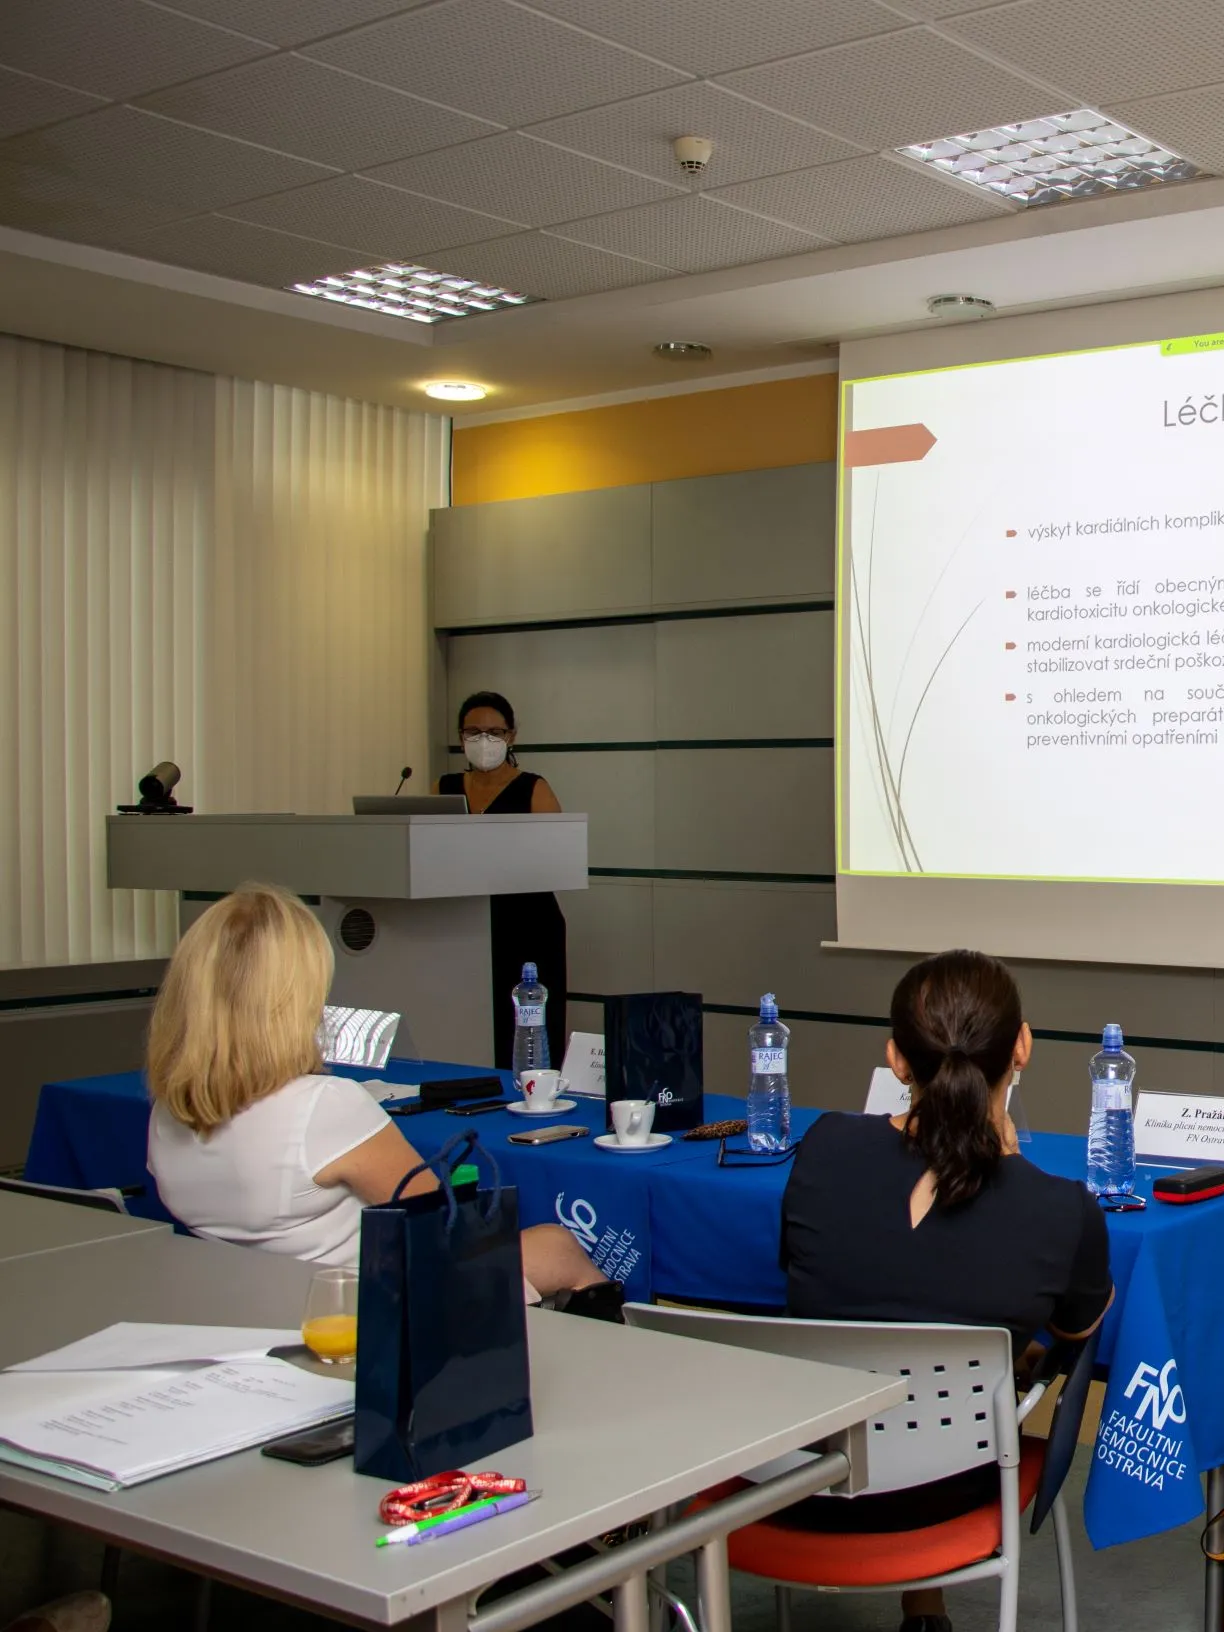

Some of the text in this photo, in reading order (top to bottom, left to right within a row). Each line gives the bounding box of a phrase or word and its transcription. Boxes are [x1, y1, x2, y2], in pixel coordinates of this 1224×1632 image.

[1192, 338, 1210, 348] You
[1210, 338, 1224, 346] are
[1027, 521, 1072, 541] výskyt
[1075, 515, 1160, 536] kardiálních
[1026, 584, 1071, 601] léčba
[1085, 585, 1102, 598] se
[1116, 579, 1141, 596] řídí
[1026, 602, 1128, 622] kardiotoxicitu
[1026, 634, 1091, 652] moderní
[1094, 630, 1201, 651] kardiologická
[1026, 655, 1110, 673] stabilizovat
[1112, 652, 1172, 670] srdeční
[1025, 692, 1033, 704] s
[1052, 687, 1122, 703] ohledem
[1143, 688, 1165, 702] na
[1026, 708, 1137, 728] onkologických
[1026, 728, 1218, 749] preventivními opatřeními
[758, 1052, 784, 1061] RAJEC
[1181, 1108, 1191, 1118] Z.
[1144, 1118, 1172, 1129] Klinika
[1186, 1133, 1199, 1143] FN
[1108, 1409, 1184, 1458] FAKULTNÍ
[1097, 1443, 1165, 1491] OSTRAVA
